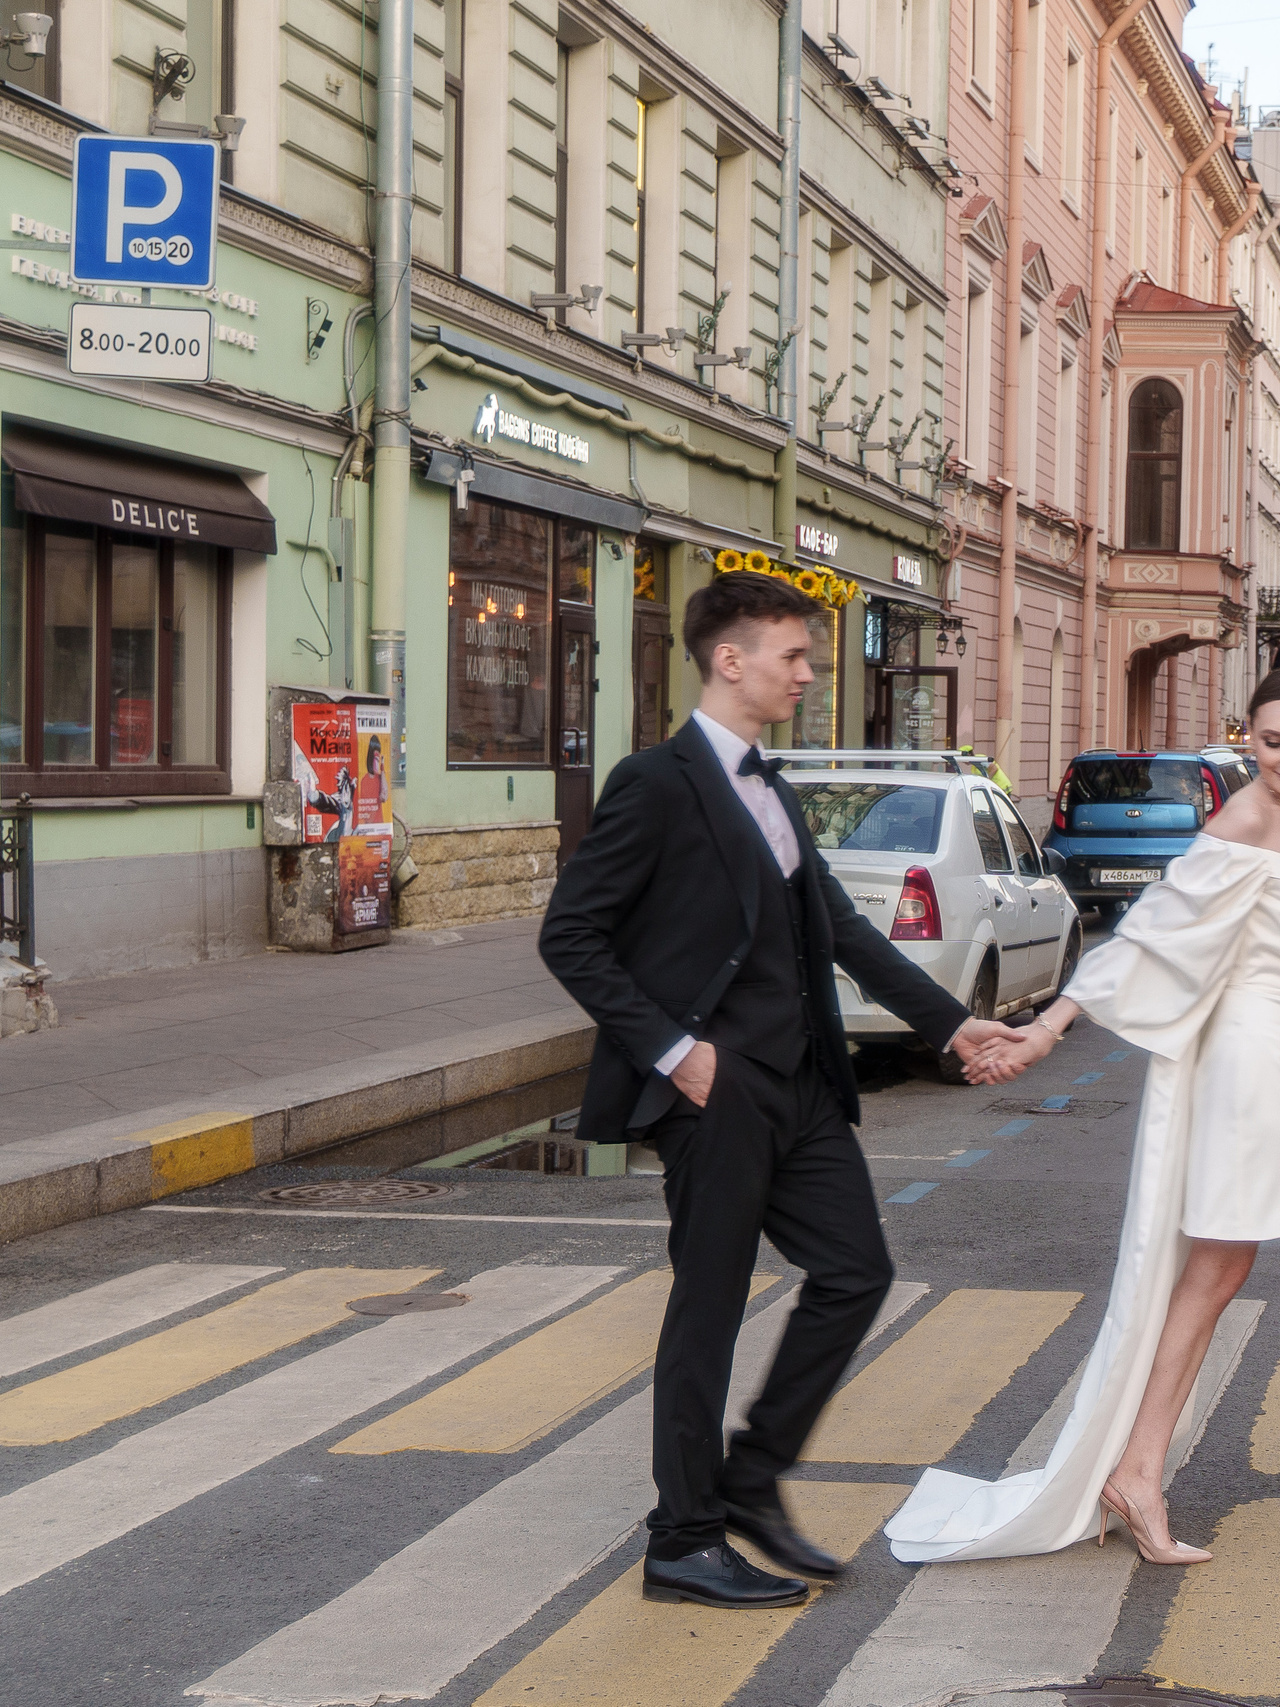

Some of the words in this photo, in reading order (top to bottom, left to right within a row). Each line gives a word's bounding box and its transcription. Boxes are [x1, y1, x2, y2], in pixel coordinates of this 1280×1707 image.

[105, 150, 183, 263] P
[133, 243, 144, 253] 10
[149, 242, 162, 255] 15
[167, 241, 190, 258] 20
[79, 327, 201, 358] 8.00-20.00
[498, 409, 530, 443] BAGGINS
[531, 422, 557, 453] COFFEE
[558, 432, 589, 464] КОФЕЙНЯ
[112, 498, 200, 536] DELIC'E
[800, 524, 839, 557] КАФЕ-БАР
[471, 581, 488, 609] МЫ
[489, 584, 527, 616] ГОТОВИМ
[465, 617, 508, 649] ВКУСНЫЙ
[509, 623, 532, 652] КОФЕ
[466, 653, 506, 687] КАЖДЫЙ
[507, 659, 530, 689] ДЕНЬ
[1144, 870, 1159, 878] 178
